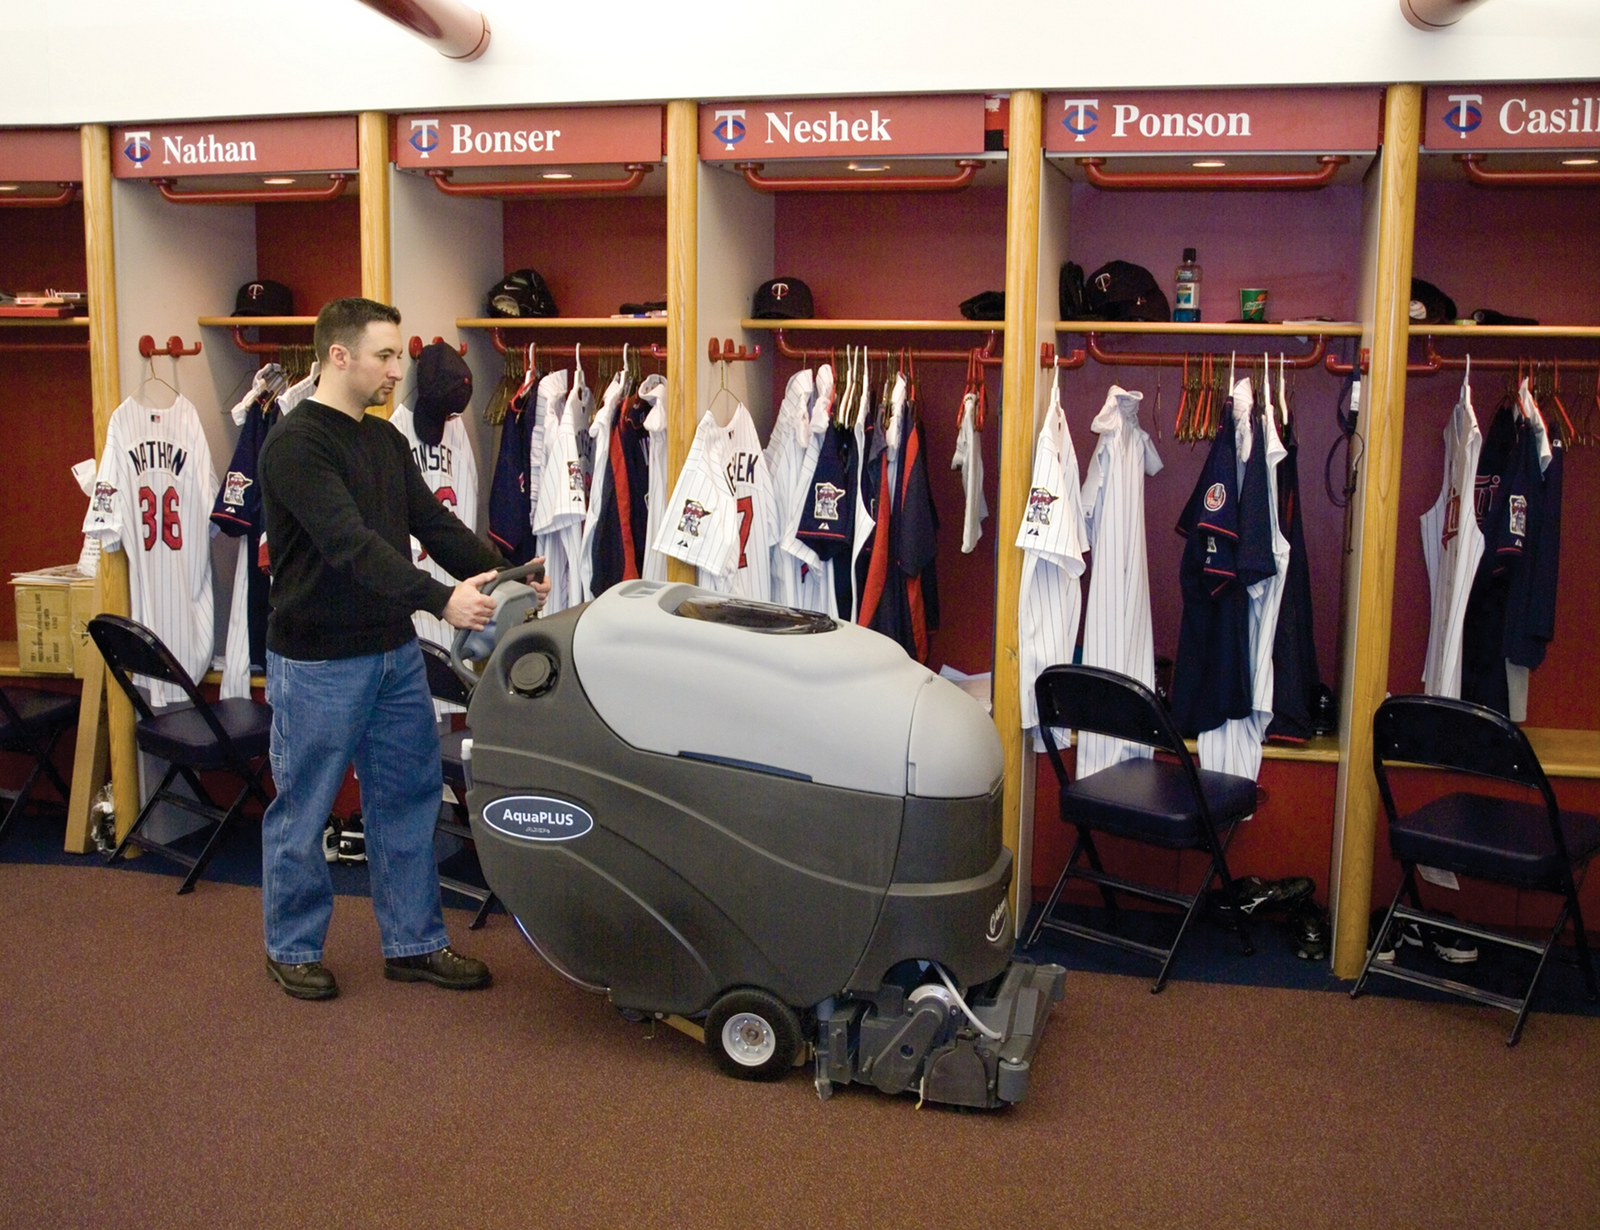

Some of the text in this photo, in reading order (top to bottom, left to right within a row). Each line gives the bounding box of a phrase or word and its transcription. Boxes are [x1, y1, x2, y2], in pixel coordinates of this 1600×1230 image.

[764, 110, 892, 143] Neshek
[1111, 104, 1252, 137] Ponson
[162, 134, 257, 164] Nathan
[450, 124, 561, 154] Bonser
[128, 441, 188, 477] NATHAN
[138, 486, 183, 551] 36
[503, 808, 574, 826] AquaPLUS
